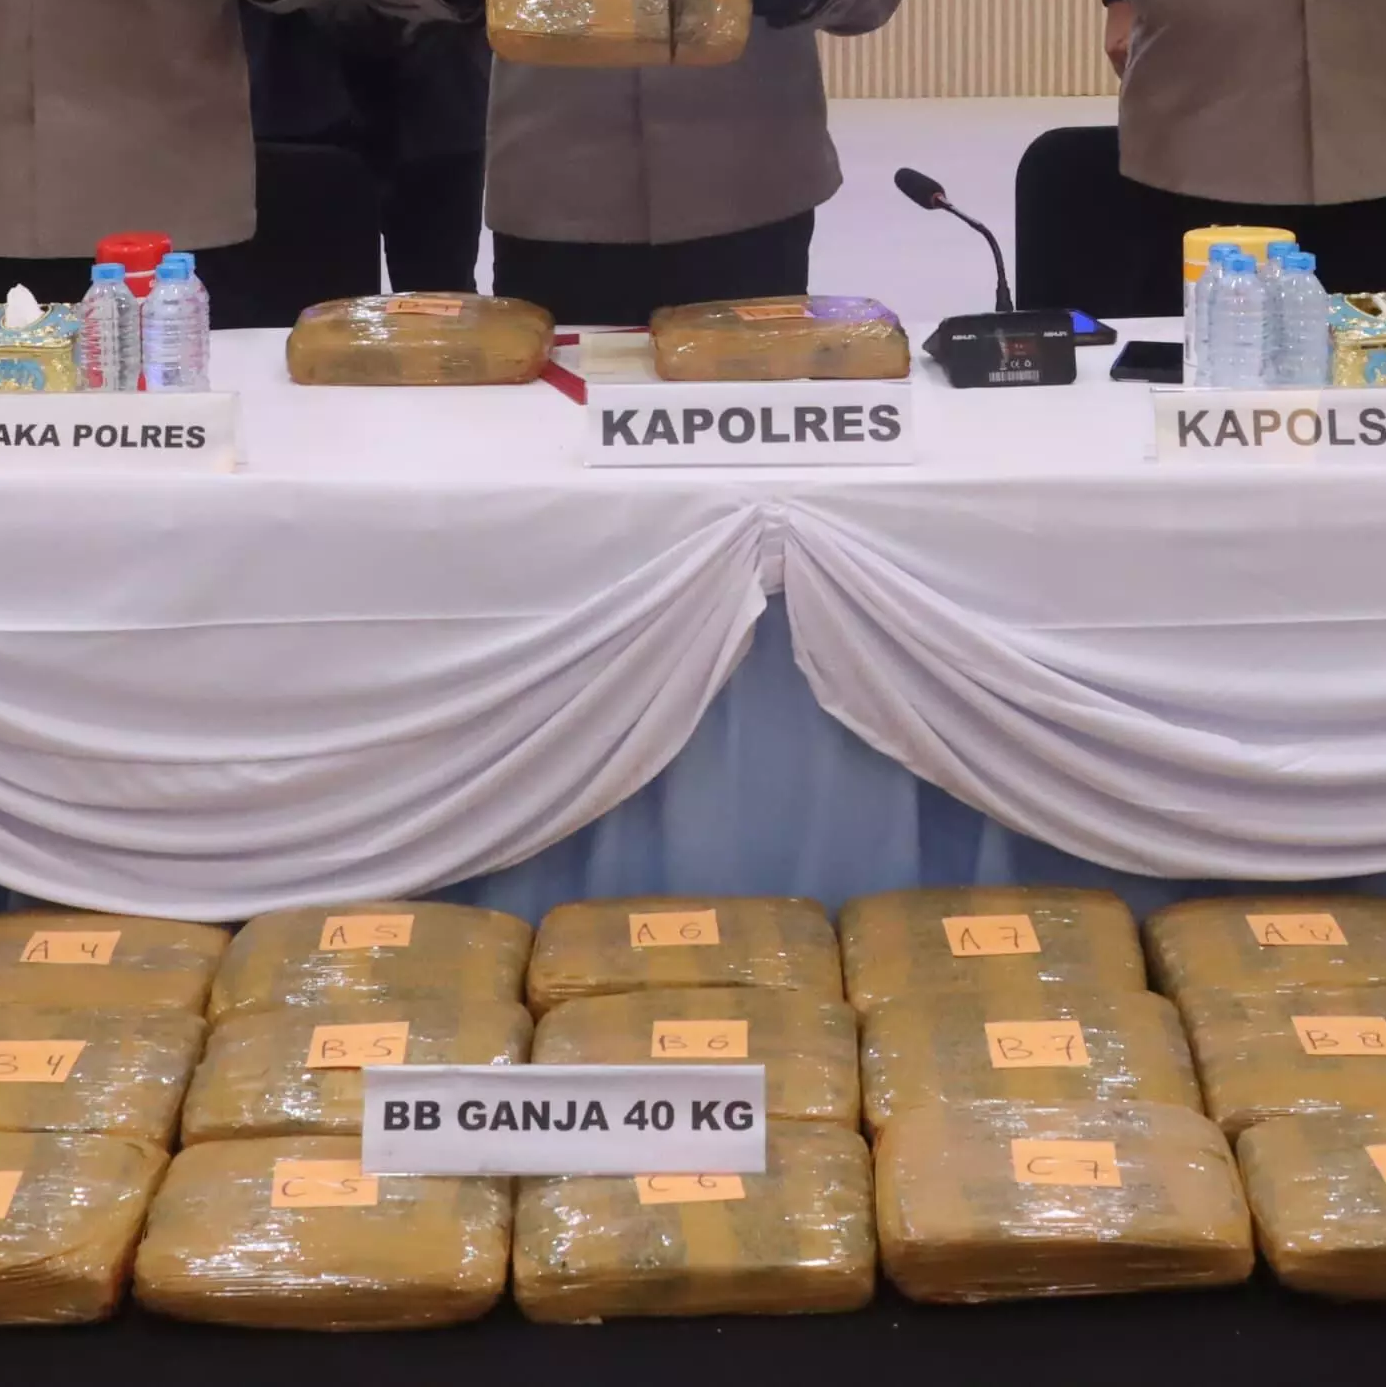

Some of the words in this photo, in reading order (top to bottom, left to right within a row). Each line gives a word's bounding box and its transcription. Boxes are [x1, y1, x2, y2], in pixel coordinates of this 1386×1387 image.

[73, 424, 206, 449] POLRES
[602, 404, 901, 446] KAPOLRES
[383, 1100, 441, 1131] BB
[457, 1100, 609, 1132] GANJA
[623, 1100, 675, 1131] 40
[691, 1100, 754, 1131] KG
